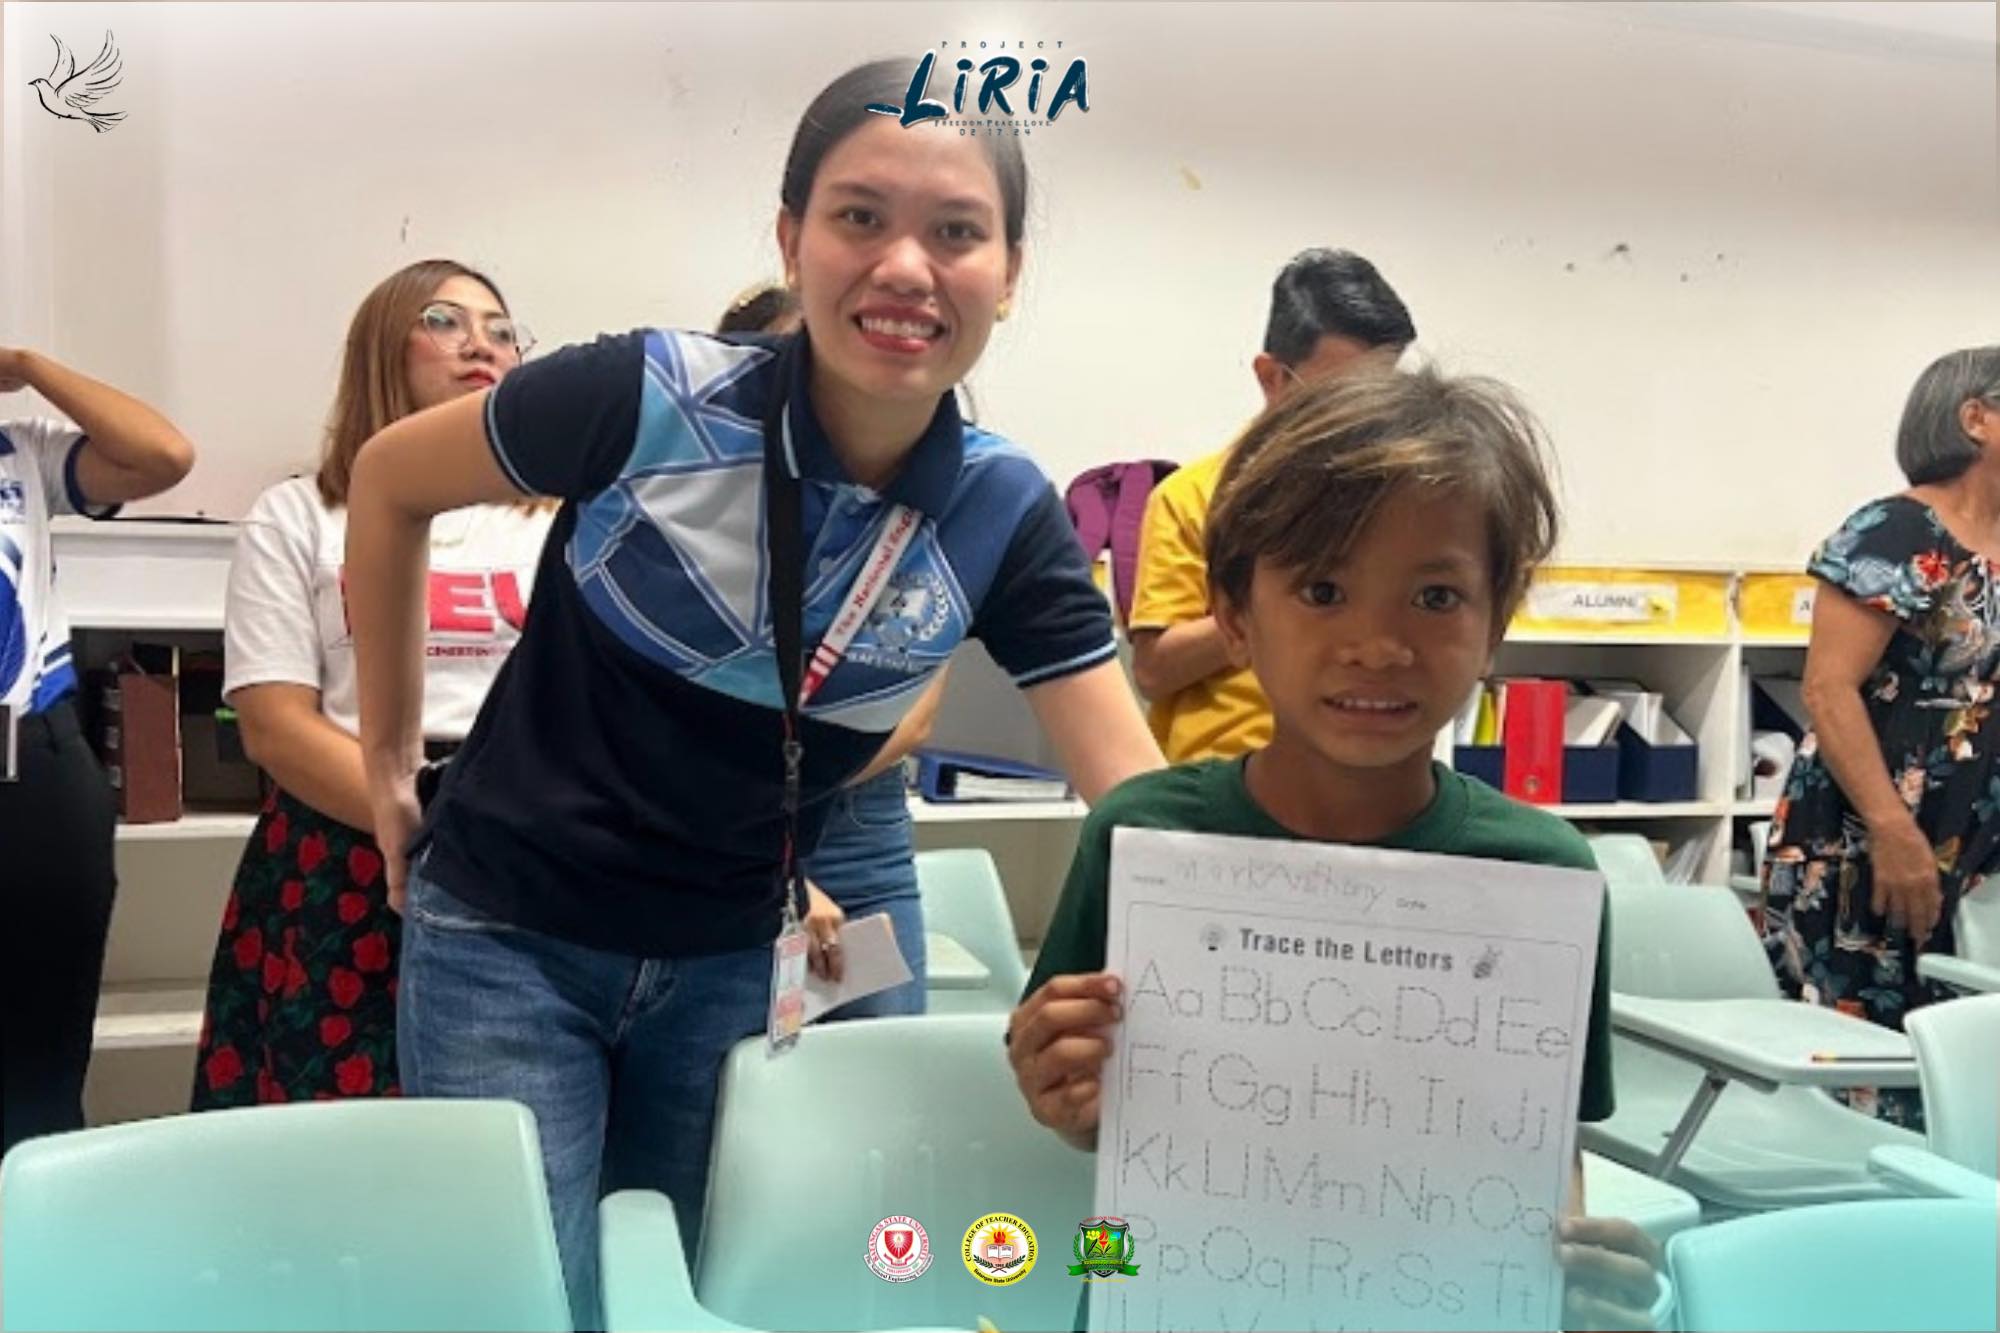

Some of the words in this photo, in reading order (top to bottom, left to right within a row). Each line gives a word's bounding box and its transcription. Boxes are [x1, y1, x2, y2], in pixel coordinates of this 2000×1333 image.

[1572, 593, 1637, 608] ALUMNI
[1239, 928, 1305, 956] Trace
[1315, 937, 1354, 961] the
[1365, 940, 1453, 972] Letters
[1128, 959, 1202, 1017] Aa
[1221, 964, 1292, 1026] Bb
[1303, 976, 1382, 1036] Cc
[1395, 984, 1480, 1046] Dd
[1497, 996, 1571, 1057] Ee
[1128, 1042, 1198, 1104] Ff
[1207, 1052, 1292, 1126] Gg
[1310, 1063, 1392, 1128] Hh
[1490, 1087, 1548, 1151] Jj
[1122, 1129, 1191, 1191] Kk
[1202, 1139, 1250, 1199] Ll
[1264, 1146, 1367, 1215] Mm
[1380, 1163, 1455, 1224] Nn
[1467, 1174, 1553, 1236] Oo
[1201, 1226, 1286, 1300] Qq
[1308, 1237, 1371, 1300] Rr
[1391, 1252, 1464, 1315] Ss
